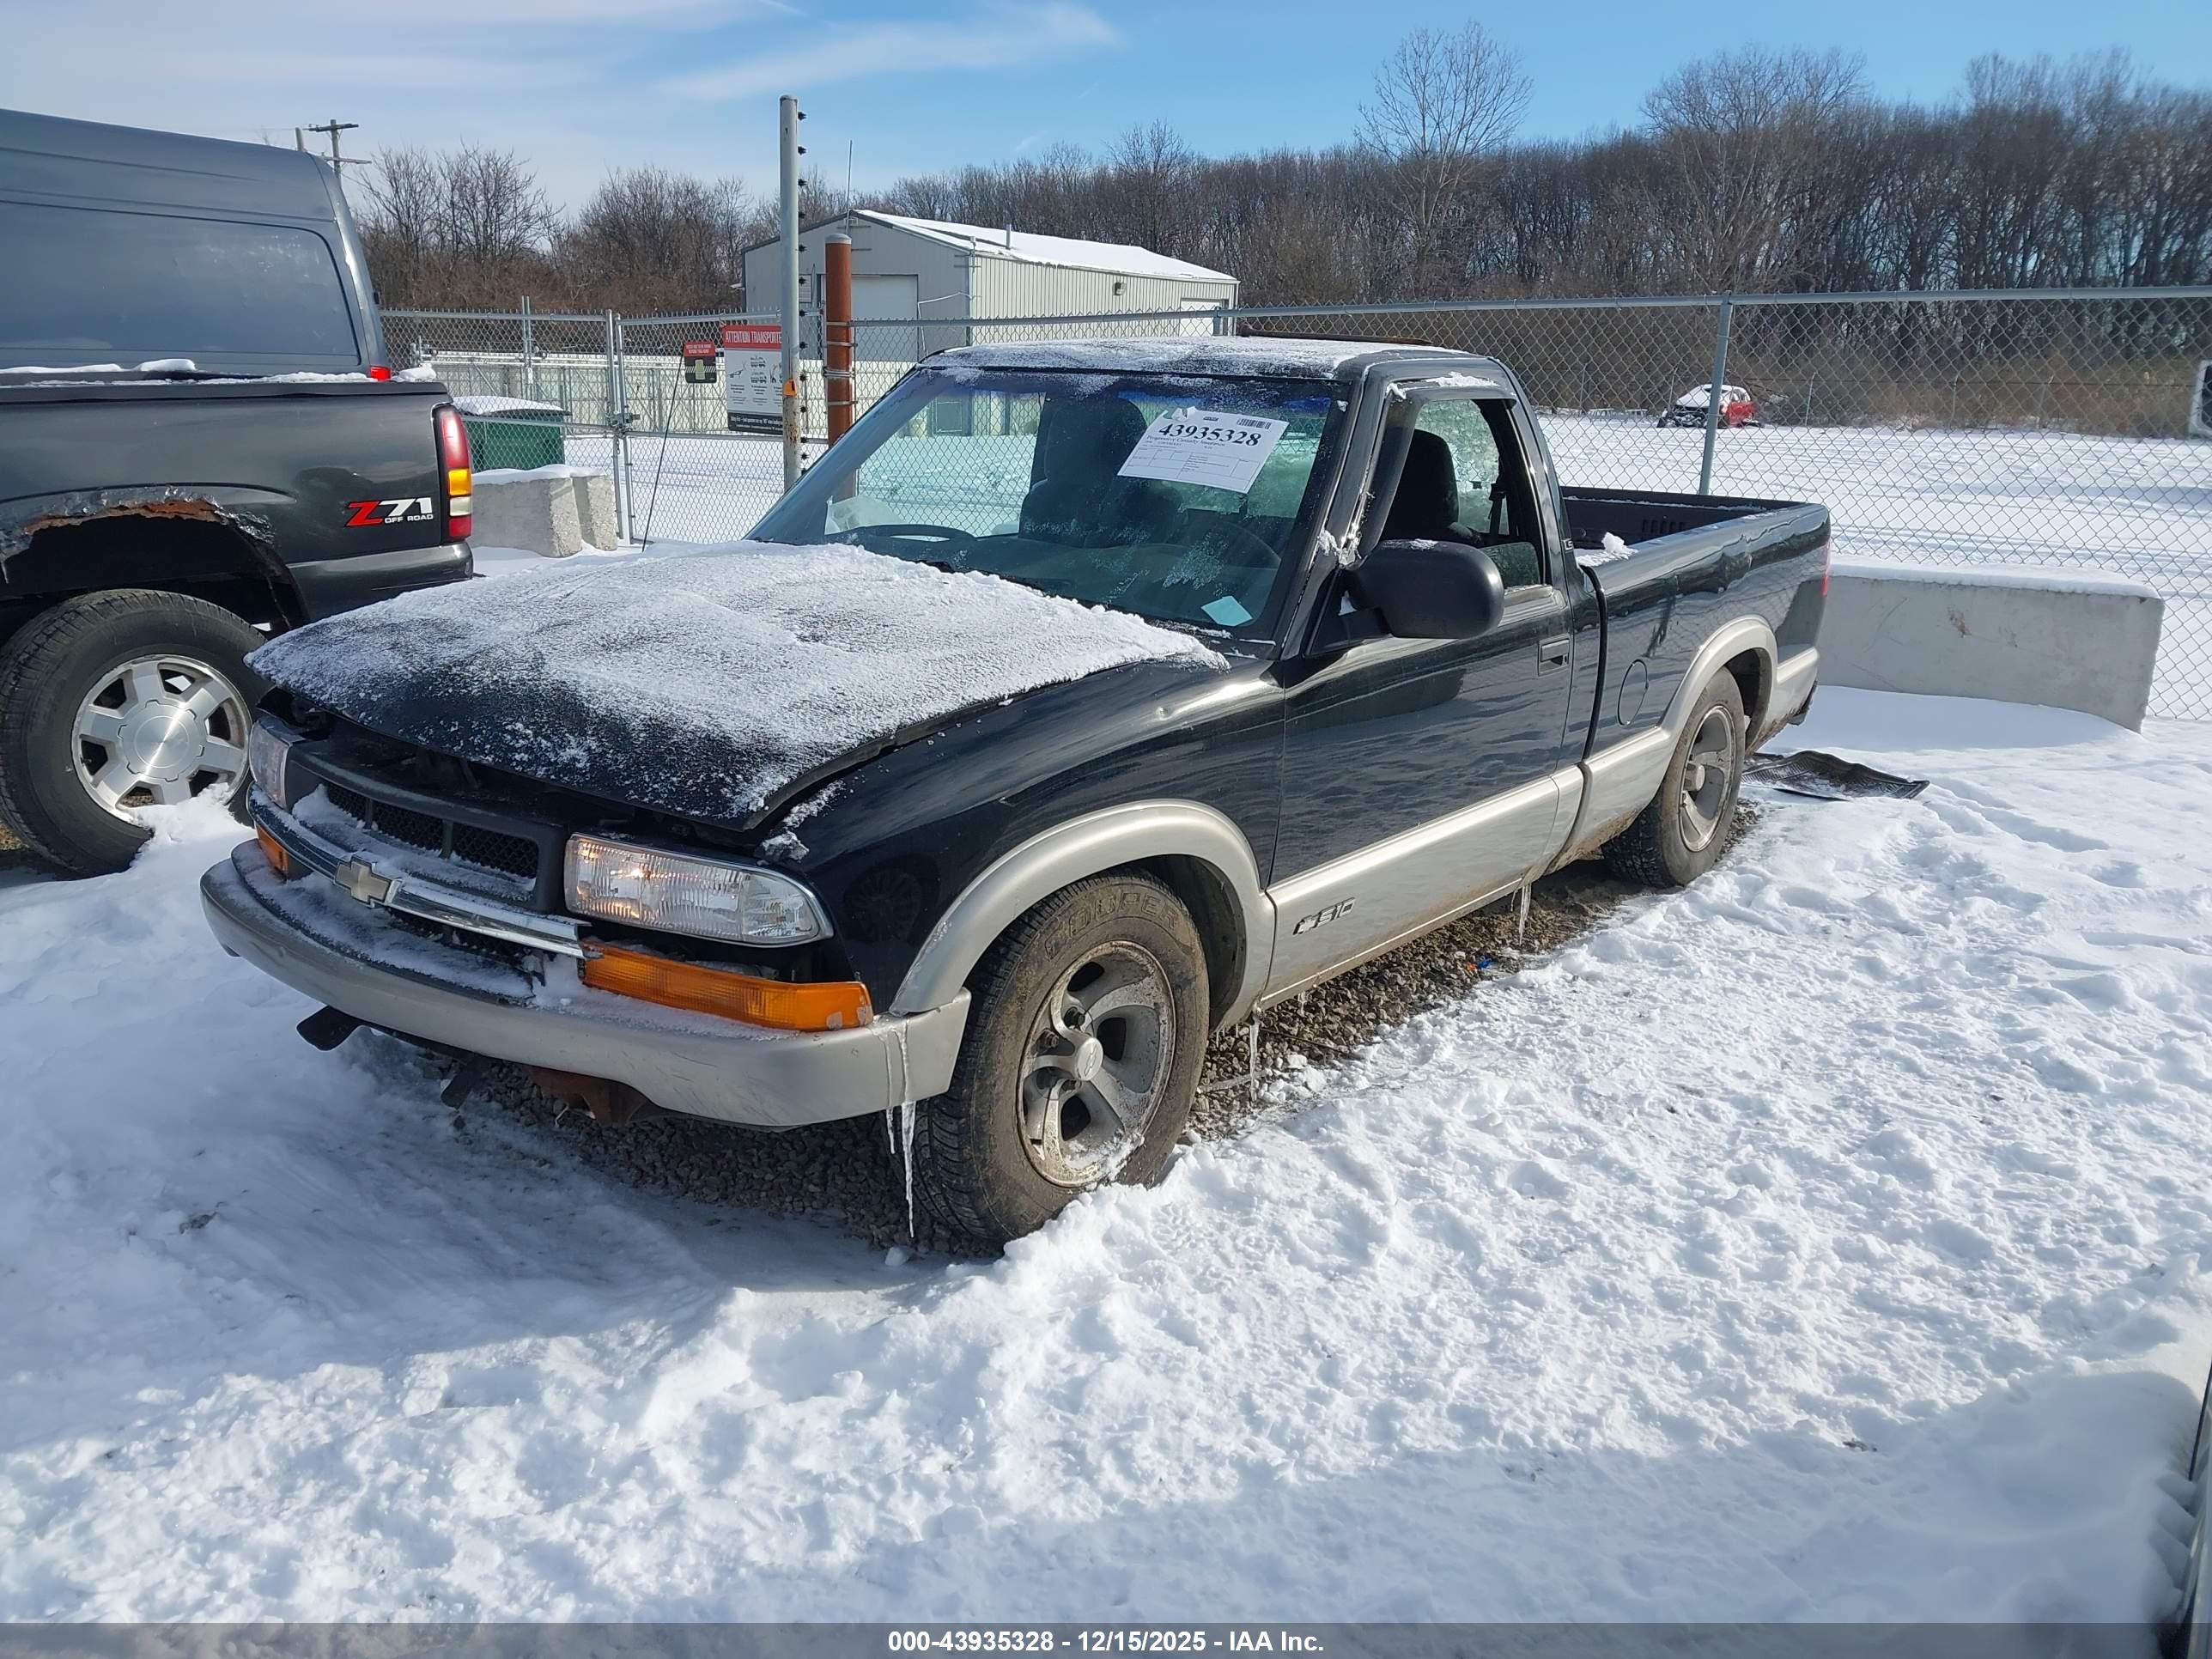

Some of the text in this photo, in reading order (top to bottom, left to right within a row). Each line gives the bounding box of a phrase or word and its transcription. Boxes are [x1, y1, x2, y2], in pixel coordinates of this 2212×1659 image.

[725, 331, 783, 344] ATTENTION TRANSPORTE
[1159, 422, 1262, 447] 43935328
[345, 496, 434, 527] Z71
[407, 514, 434, 522] ROAD
[1043, 890, 1180, 962] COOPER
